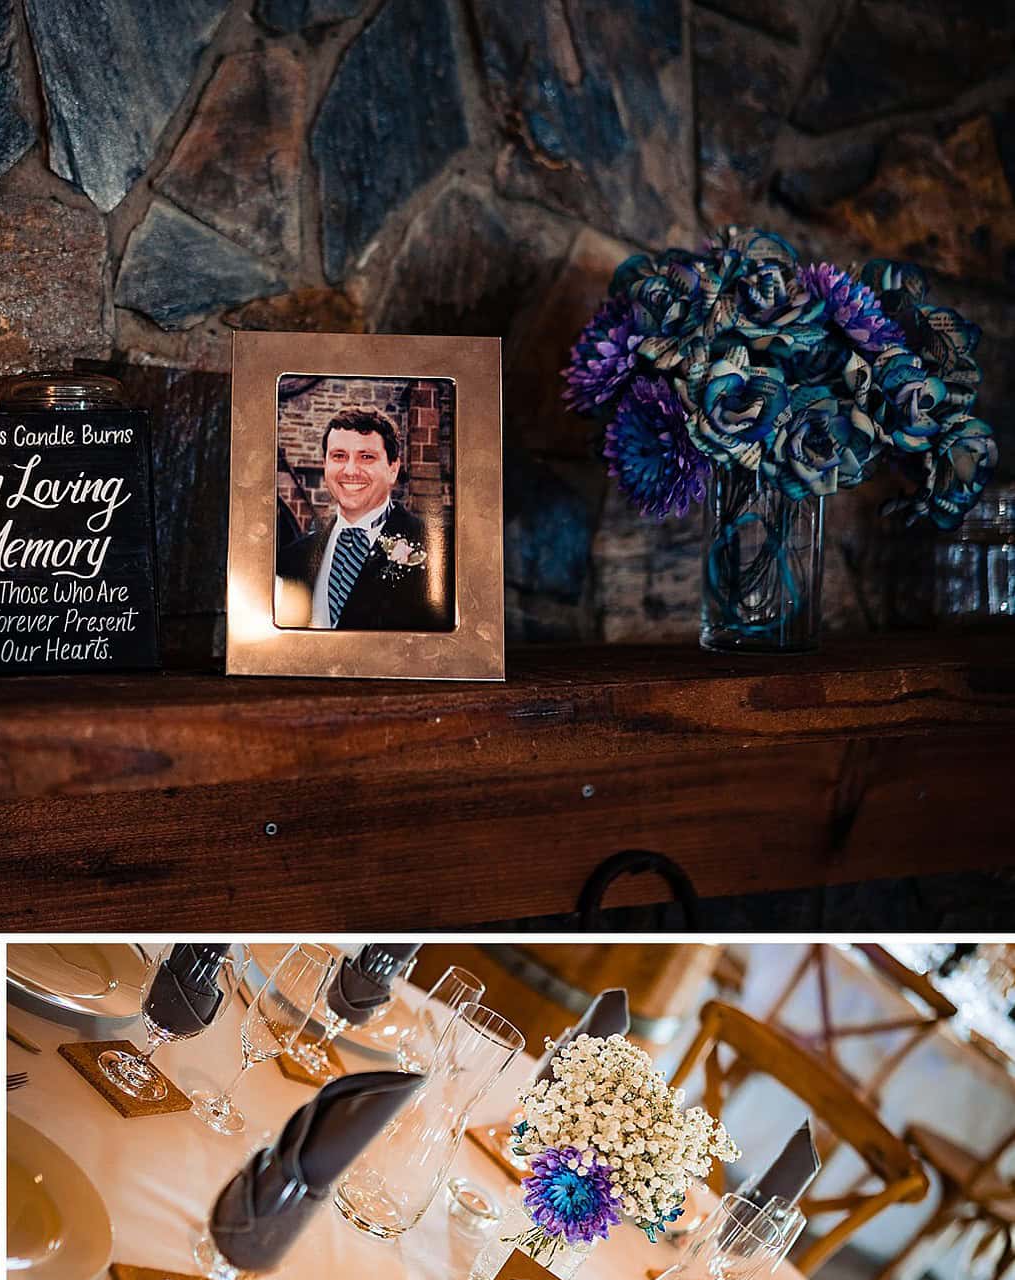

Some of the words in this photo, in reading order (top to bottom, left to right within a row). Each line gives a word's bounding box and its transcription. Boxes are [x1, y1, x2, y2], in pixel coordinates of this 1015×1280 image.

[14, 424, 75, 447] Candle
[82, 425, 133, 445] Burns
[6, 454, 132, 532] Loving
[0, 580, 48, 604] Those
[53, 581, 94, 603] Who
[96, 580, 130, 602] Are
[64, 608, 138, 633] Present
[0, 640, 41, 662] Our
[45, 636, 113, 661] Hearts.
